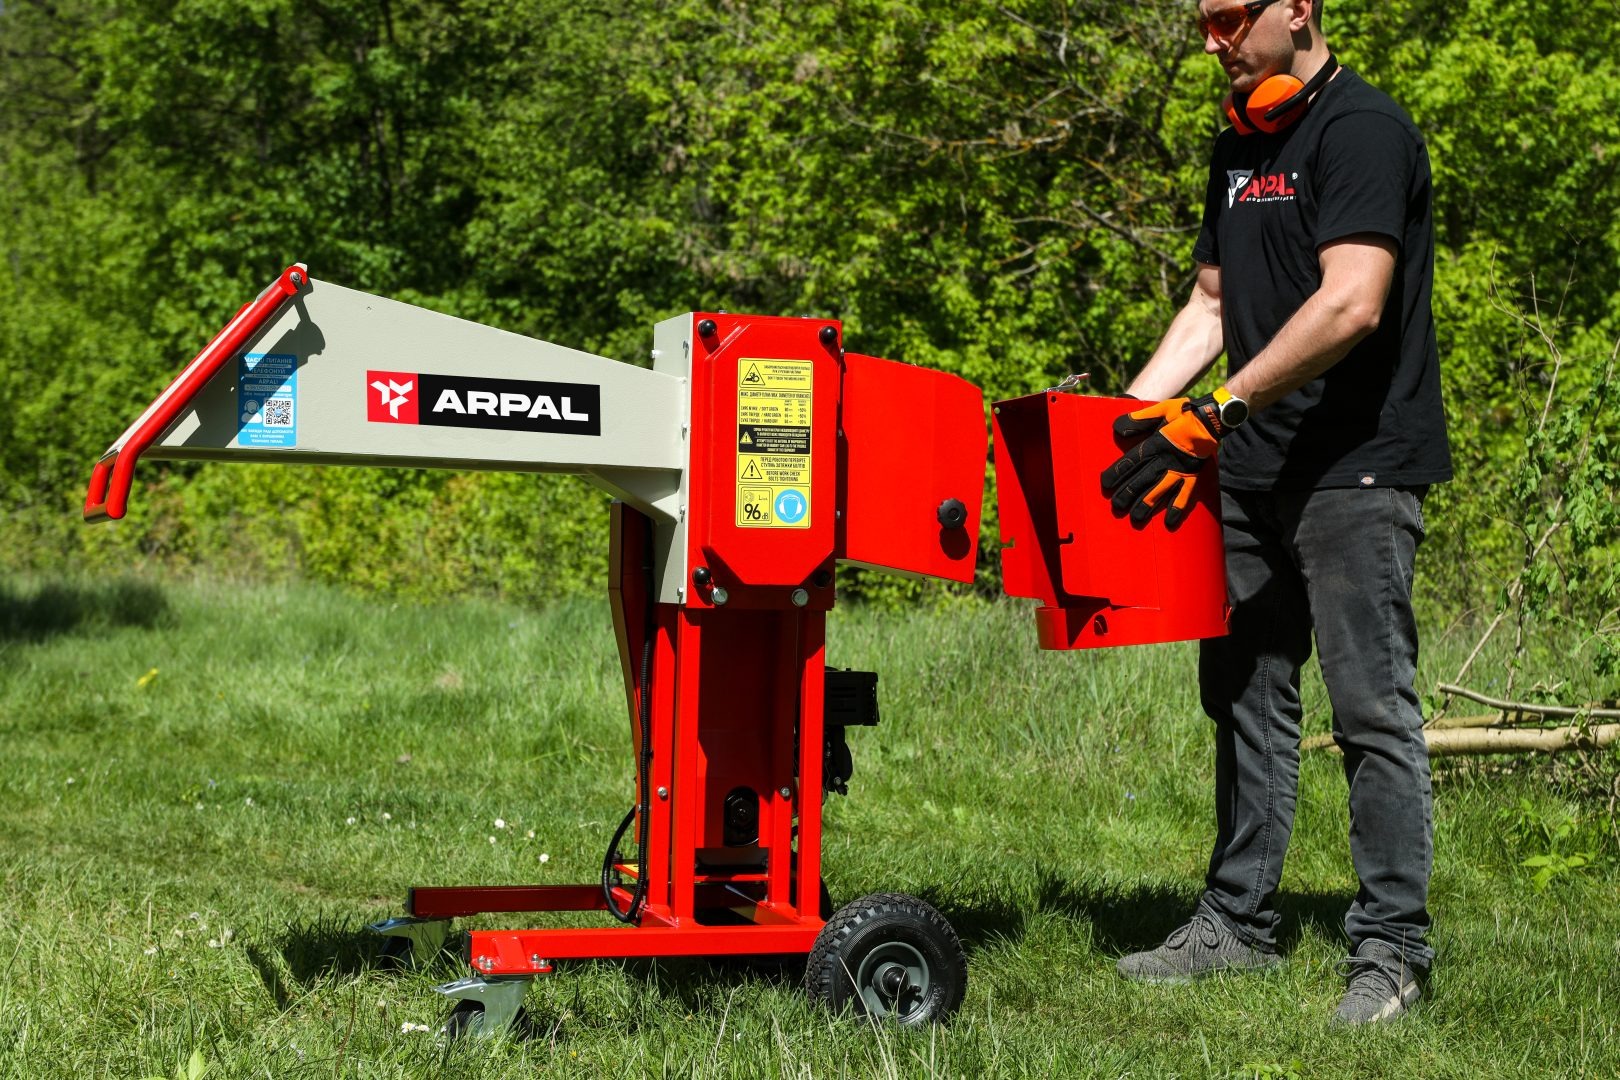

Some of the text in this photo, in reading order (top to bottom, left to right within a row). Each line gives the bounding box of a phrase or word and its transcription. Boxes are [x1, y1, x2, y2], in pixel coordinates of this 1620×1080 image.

[432, 389, 589, 422] ARPAL
[1203, 405, 1221, 435] STIHL
[744, 503, 769, 520] 96 dB
